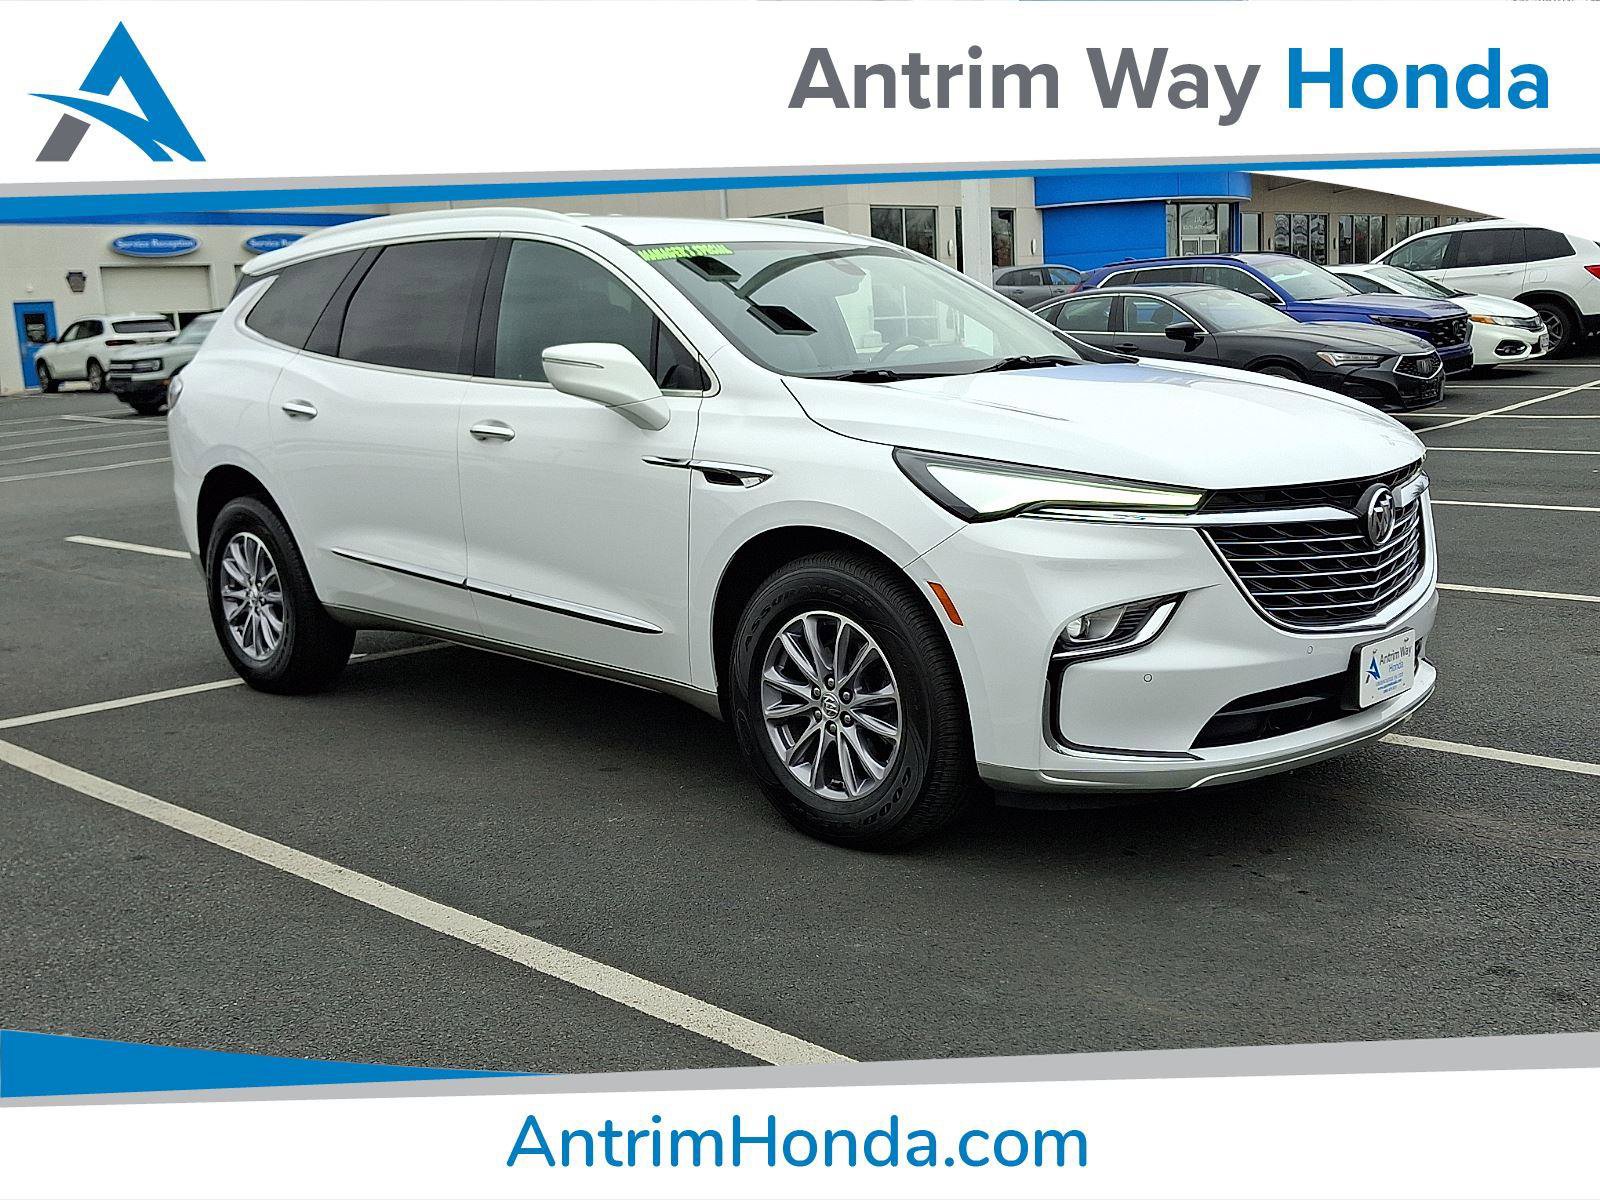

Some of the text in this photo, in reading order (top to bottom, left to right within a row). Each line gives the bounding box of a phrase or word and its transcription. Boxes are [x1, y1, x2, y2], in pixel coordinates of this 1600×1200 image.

[117, 238, 194, 248] Service Reception
[1400, 645, 1412, 658] Way
